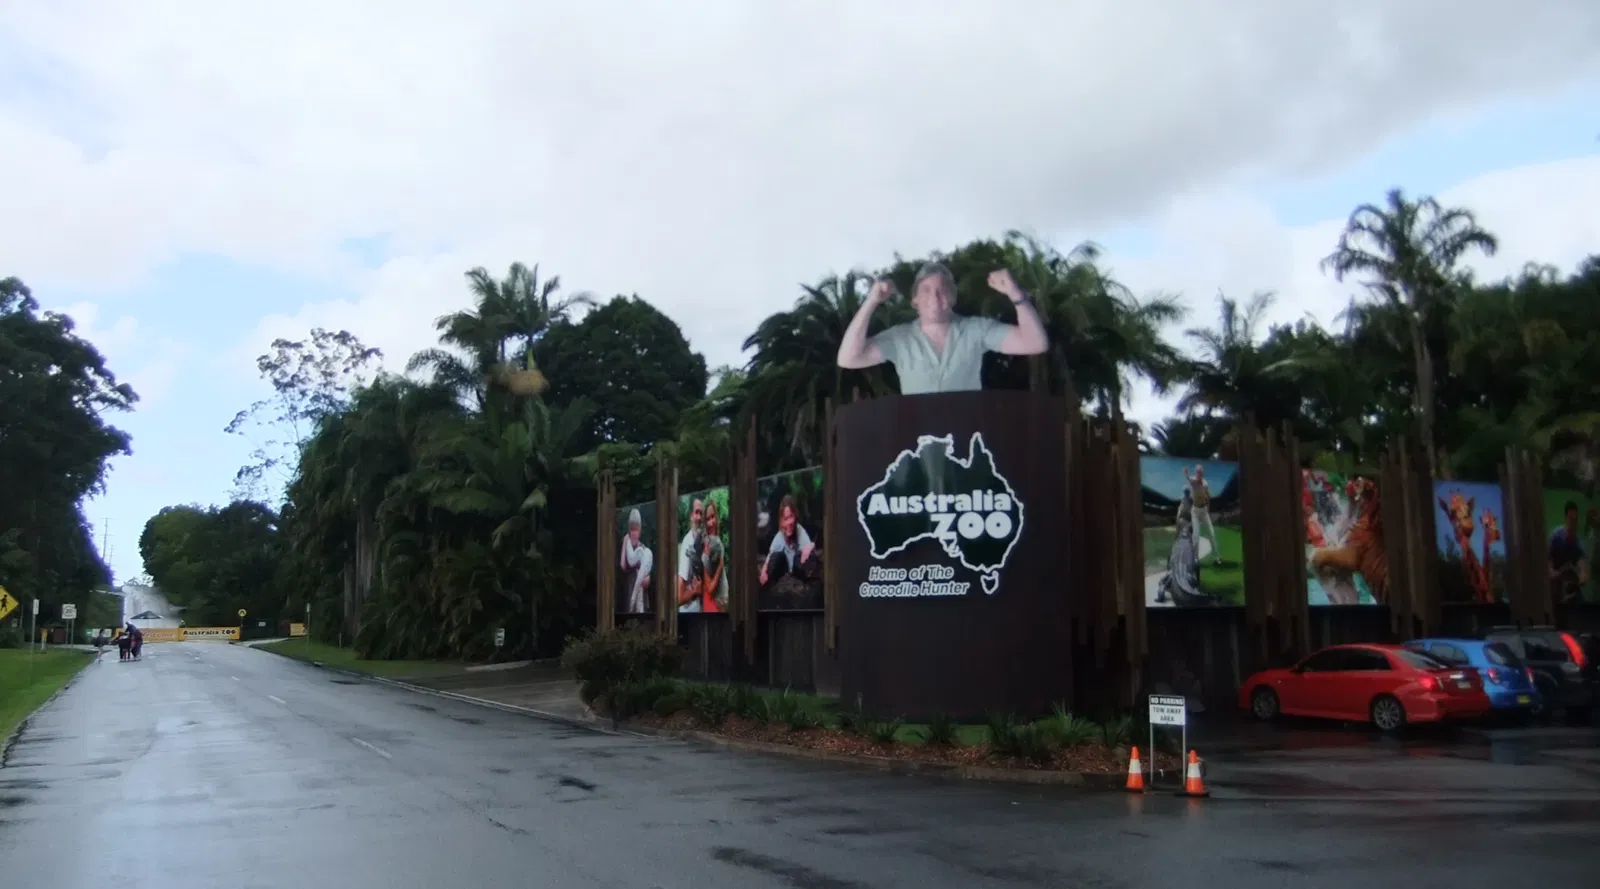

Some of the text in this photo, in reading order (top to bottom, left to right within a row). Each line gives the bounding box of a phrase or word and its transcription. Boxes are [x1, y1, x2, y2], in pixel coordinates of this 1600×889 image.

[867, 489, 1012, 516] Australia
[869, 564, 955, 581] Home of The
[859, 580, 970, 597] Crocodile Hunter
